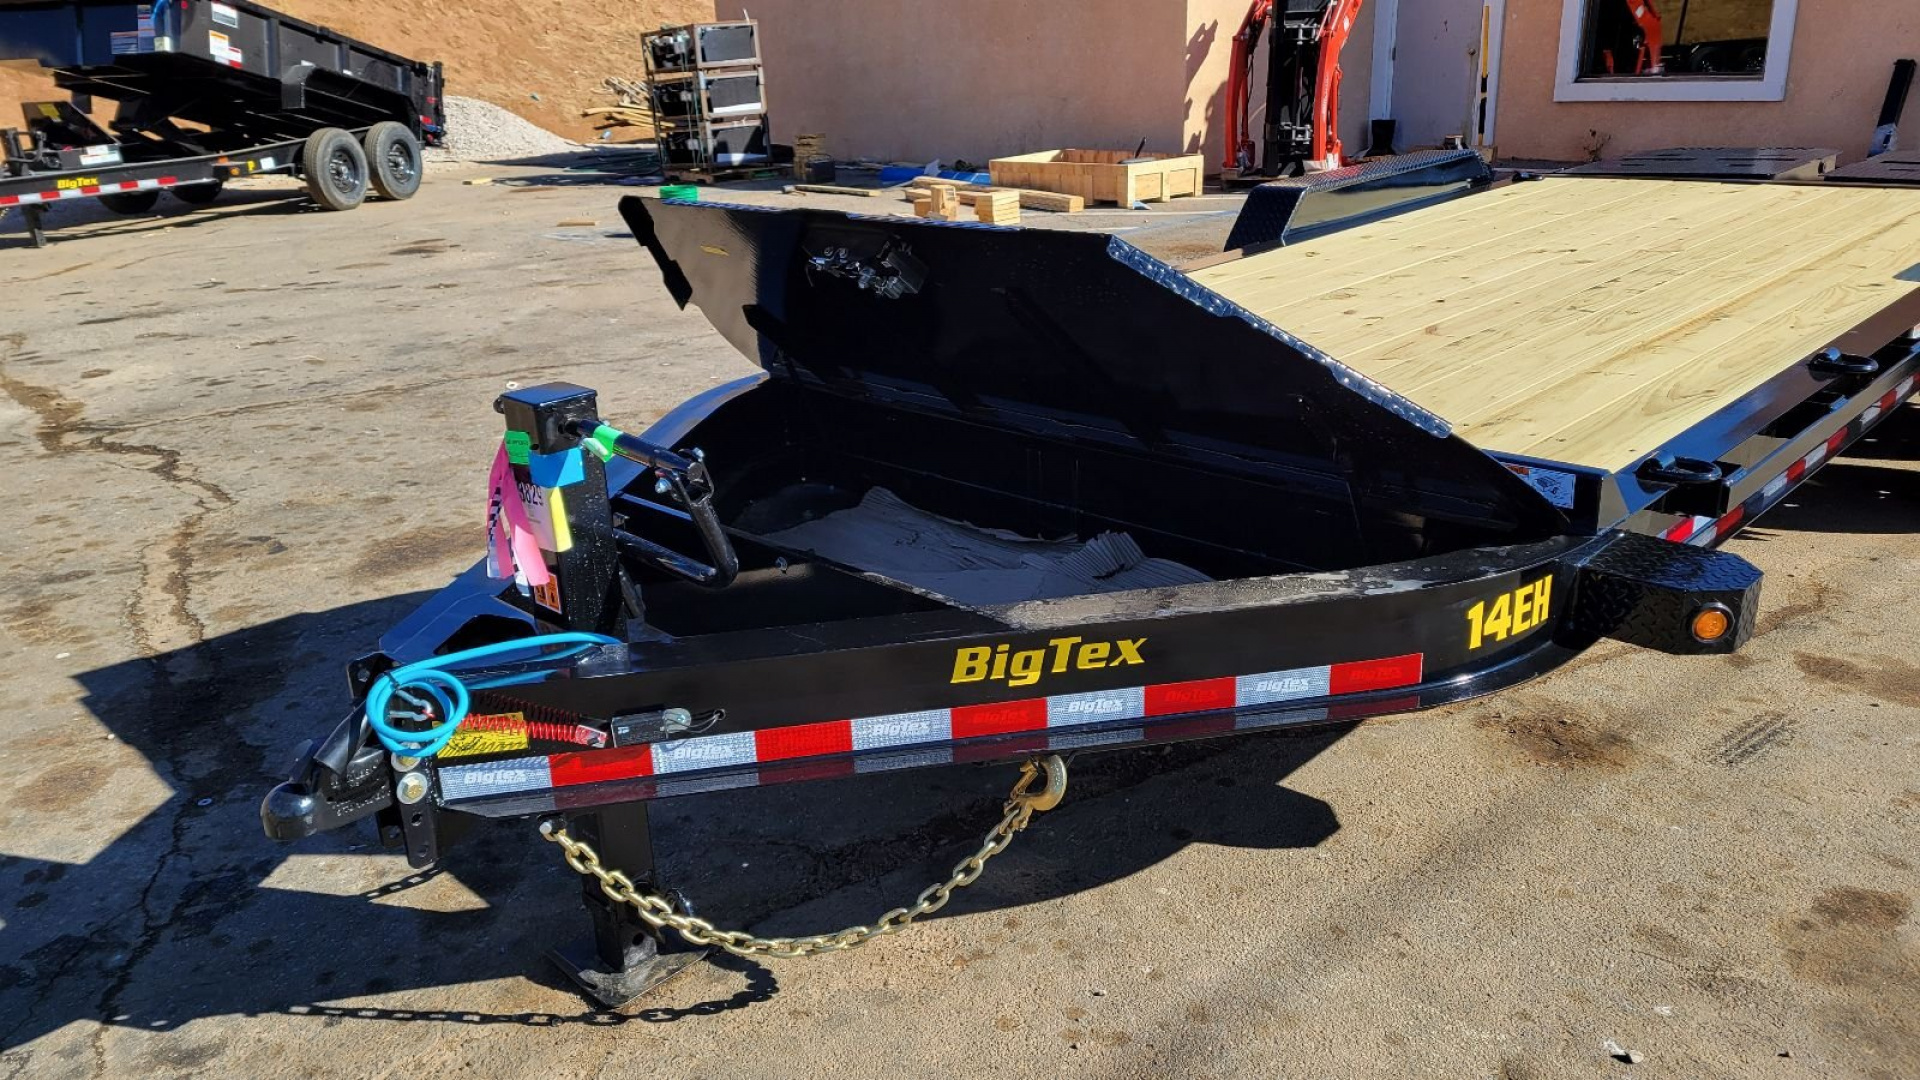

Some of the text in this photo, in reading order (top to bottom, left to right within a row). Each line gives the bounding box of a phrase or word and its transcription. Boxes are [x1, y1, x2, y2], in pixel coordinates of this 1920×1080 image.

[56, 176, 98, 190] BigTex
[1466, 574, 1553, 651] 14EH
[950, 636, 1147, 687] BigTex
[1068, 699, 1123, 714] BigTex
